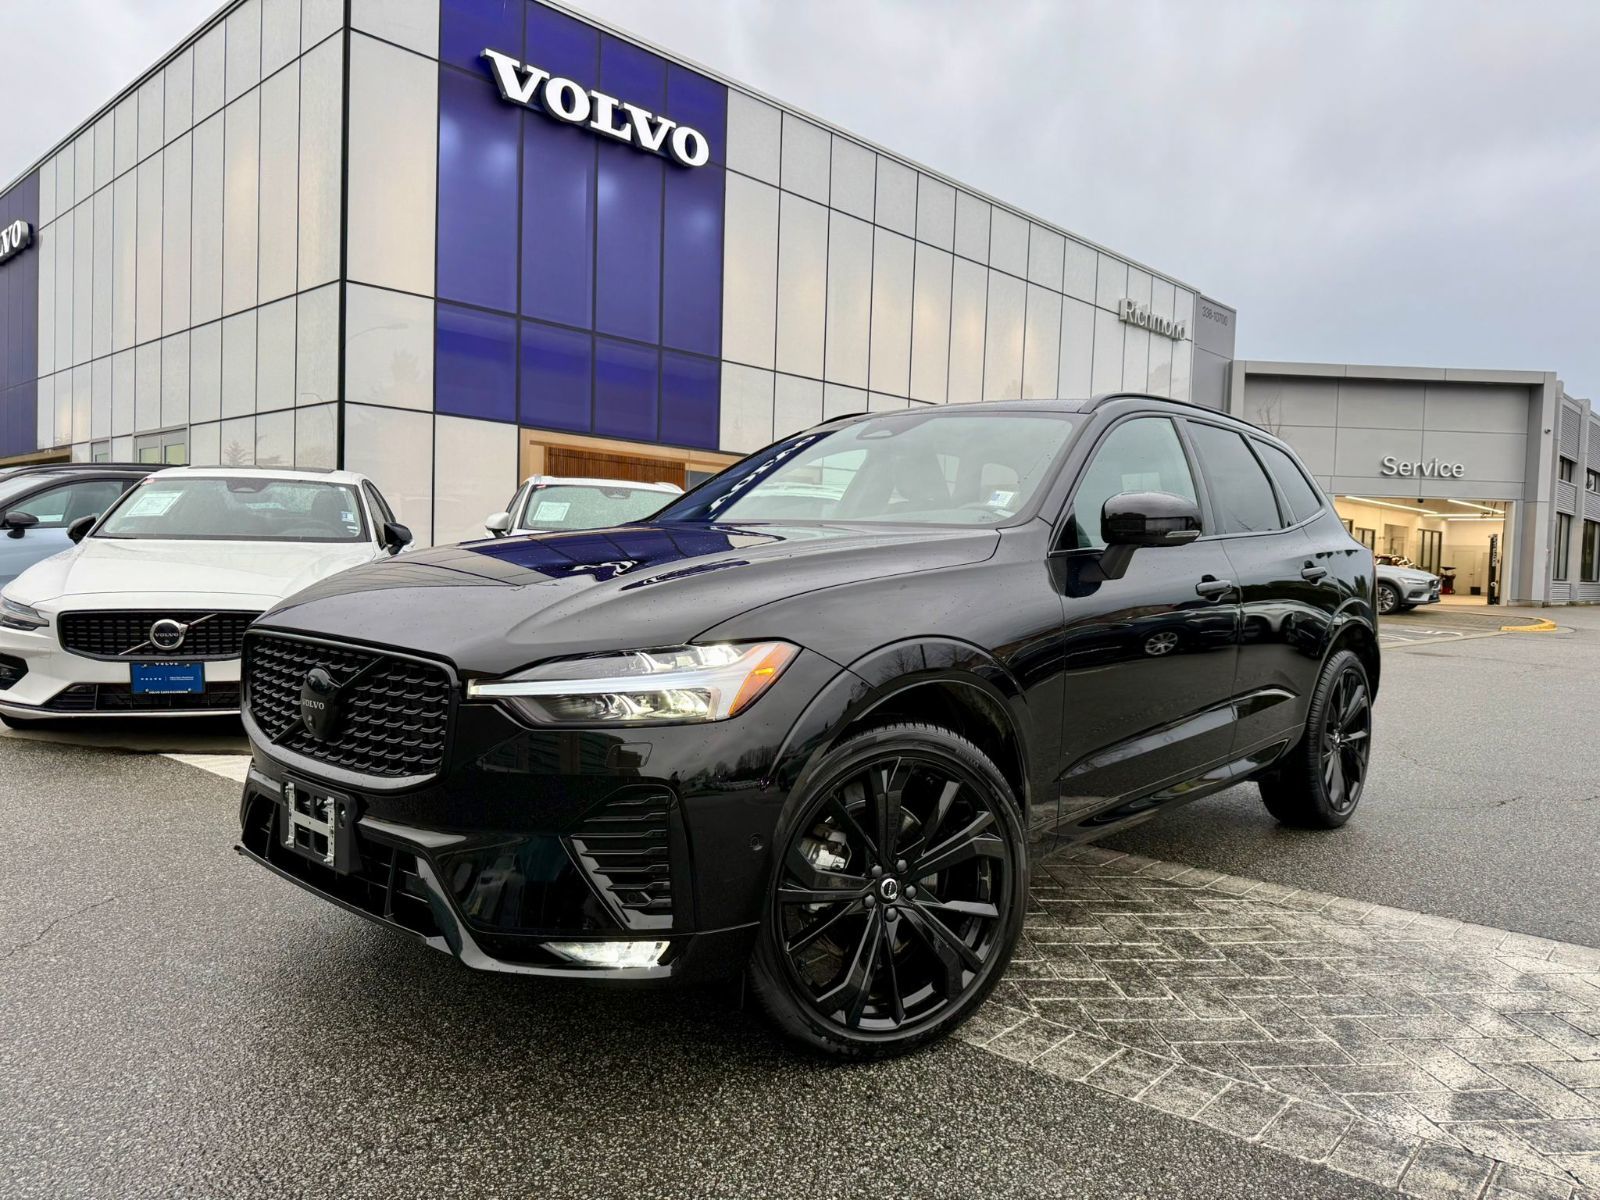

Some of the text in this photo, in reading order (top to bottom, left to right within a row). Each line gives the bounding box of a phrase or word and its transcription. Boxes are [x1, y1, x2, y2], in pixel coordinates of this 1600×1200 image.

[482, 47, 710, 167] VOLVO
[1119, 298, 1187, 341] Richmond
[1381, 456, 1465, 478] Service
[302, 699, 325, 710] VOLVO
